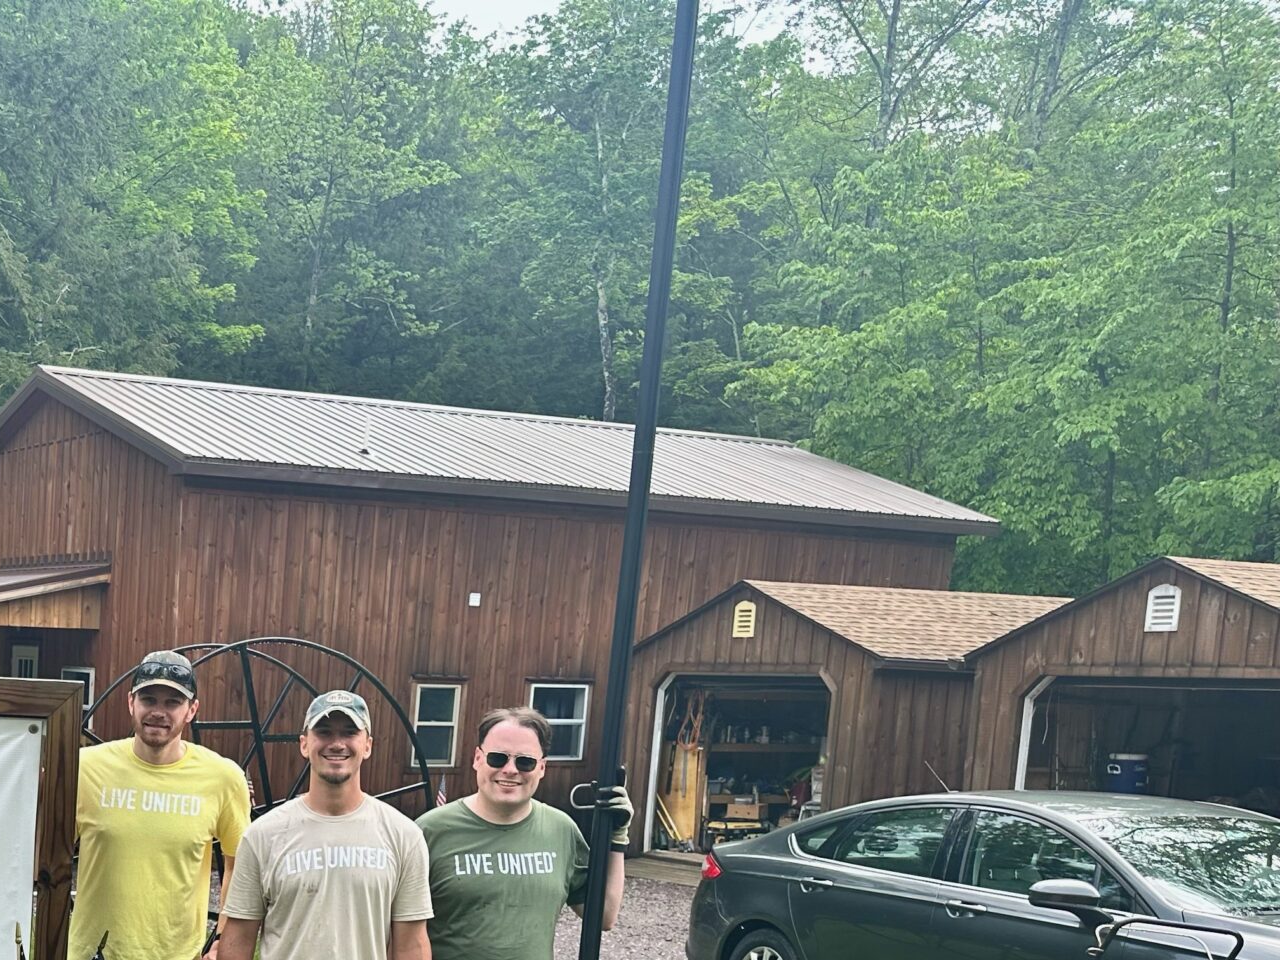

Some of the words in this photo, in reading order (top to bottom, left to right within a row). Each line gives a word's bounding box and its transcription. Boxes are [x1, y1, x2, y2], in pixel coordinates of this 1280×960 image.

[101, 785, 138, 810] LIVE
[142, 790, 201, 816] UNITED
[285, 847, 324, 875] LIVE
[327, 846, 387, 870] UNITED
[455, 853, 494, 875] LIVE
[497, 851, 554, 875] UNITED
